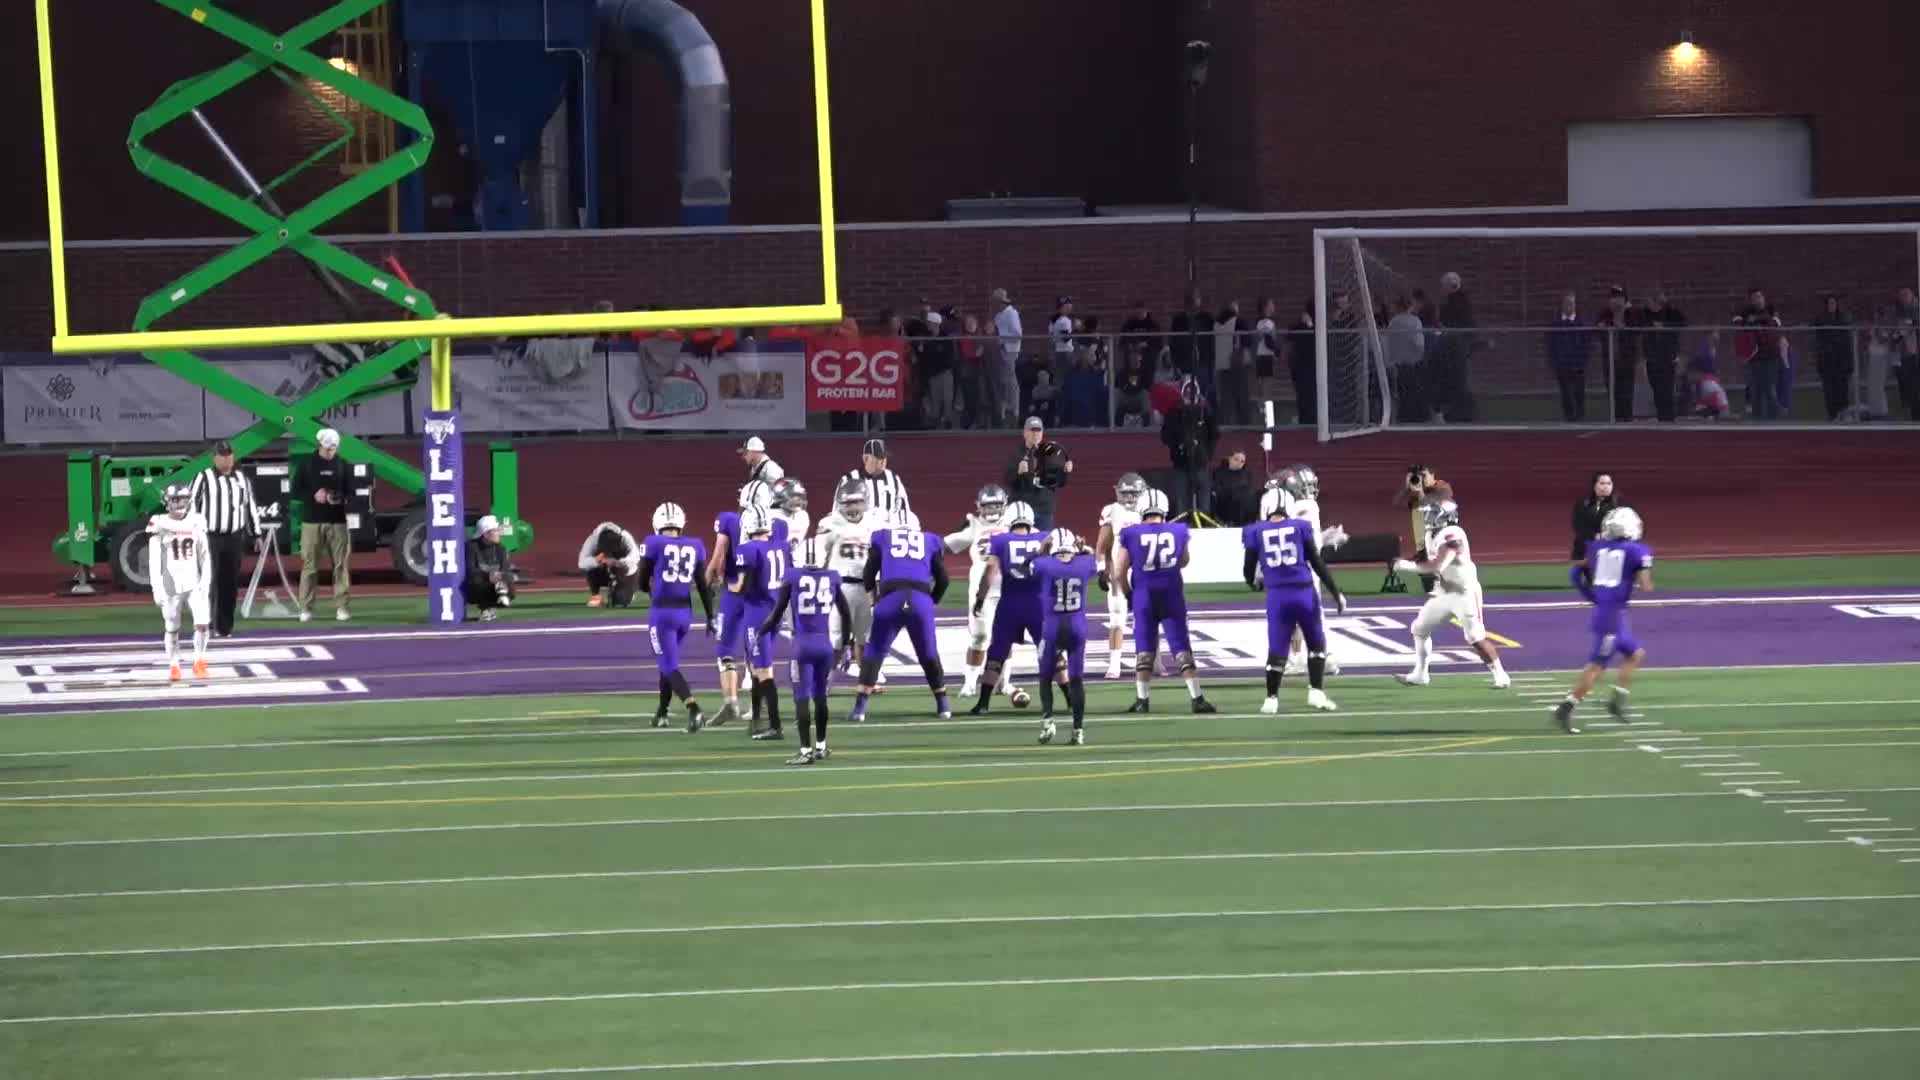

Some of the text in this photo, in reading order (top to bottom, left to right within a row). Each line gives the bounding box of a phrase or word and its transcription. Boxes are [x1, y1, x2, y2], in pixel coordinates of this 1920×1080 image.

[810, 349, 899, 385] G2G
[817, 388, 896, 398] PROTEIN BAR
[257, 502, 280, 517] x4
[429, 448, 457, 621] LEHI
[890, 529, 925, 560] 59
[1140, 532, 1177, 571] 72
[1261, 526, 1298, 567] 55
[662, 543, 697, 583] 33
[766, 549, 785, 589] 11
[797, 575, 833, 615] 24
[1053, 577, 1082, 612] 16
